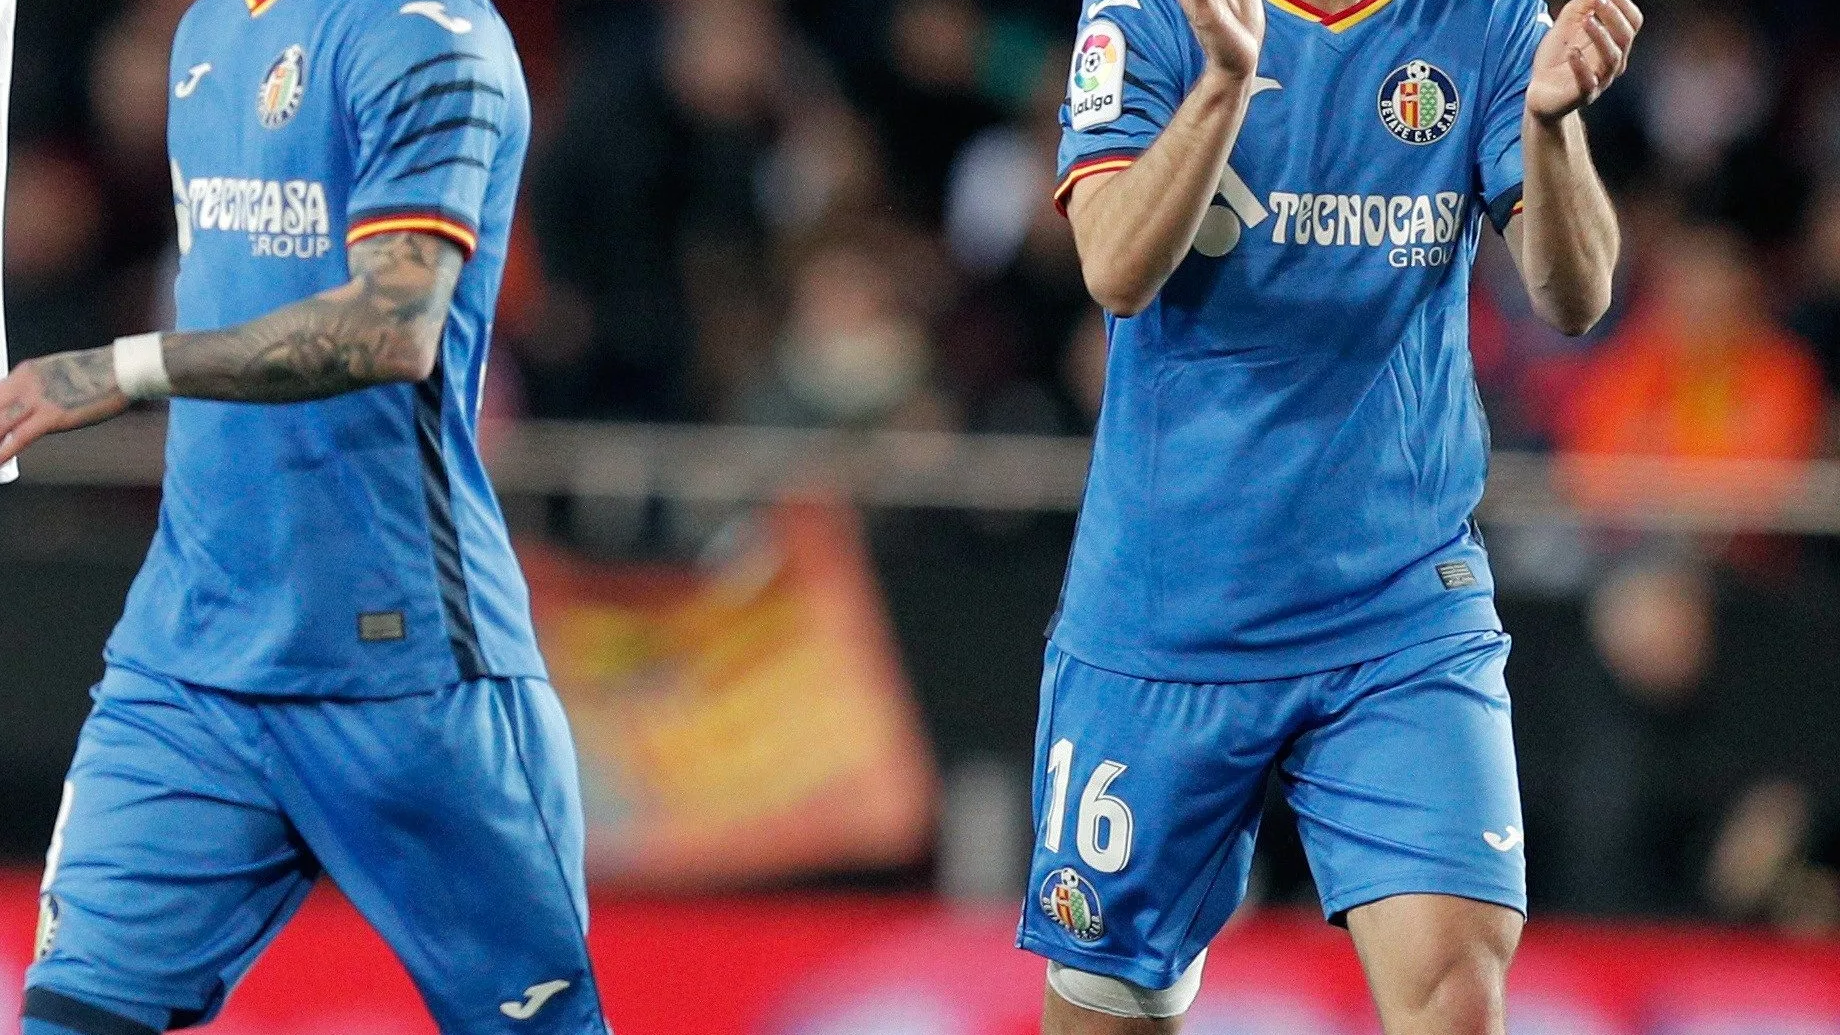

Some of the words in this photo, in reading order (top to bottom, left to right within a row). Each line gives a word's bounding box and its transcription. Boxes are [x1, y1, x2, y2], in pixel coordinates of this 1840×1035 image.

[1073, 93, 1114, 117] LaLiga
[1381, 100, 1411, 139] GETAFE
[1414, 129, 1437, 142] C.F.
[1044, 737, 1134, 873] 16
